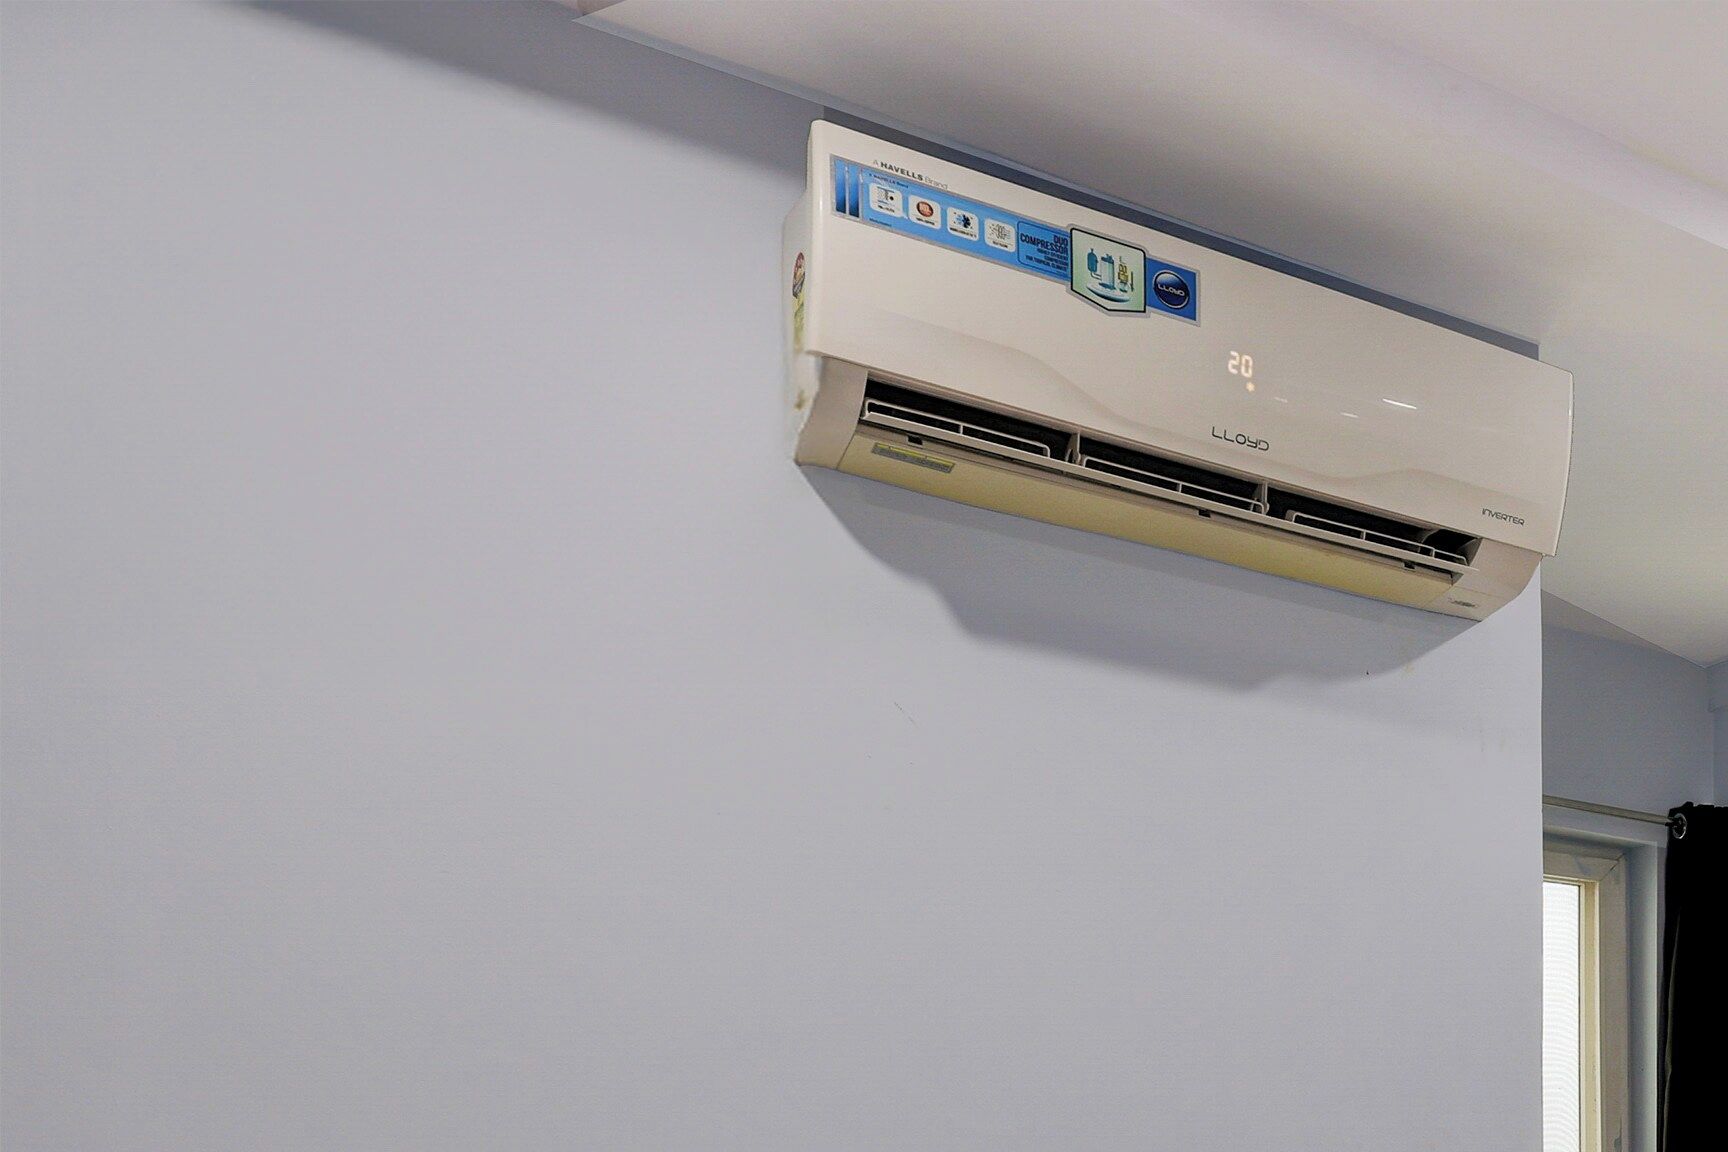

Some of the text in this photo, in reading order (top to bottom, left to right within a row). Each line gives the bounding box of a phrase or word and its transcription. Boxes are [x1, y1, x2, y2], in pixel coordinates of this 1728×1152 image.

[880, 161, 923, 181] HAVELLS
[924, 175, 948, 190] Brand
[1020, 233, 1069, 255] COMPRESSOR
[1053, 234, 1069, 246] DUO
[1157, 283, 1185, 297] LLOYD
[1227, 350, 1253, 378] 20
[1211, 426, 1270, 451] LLOYD
[1482, 508, 1525, 526] INVERTER
